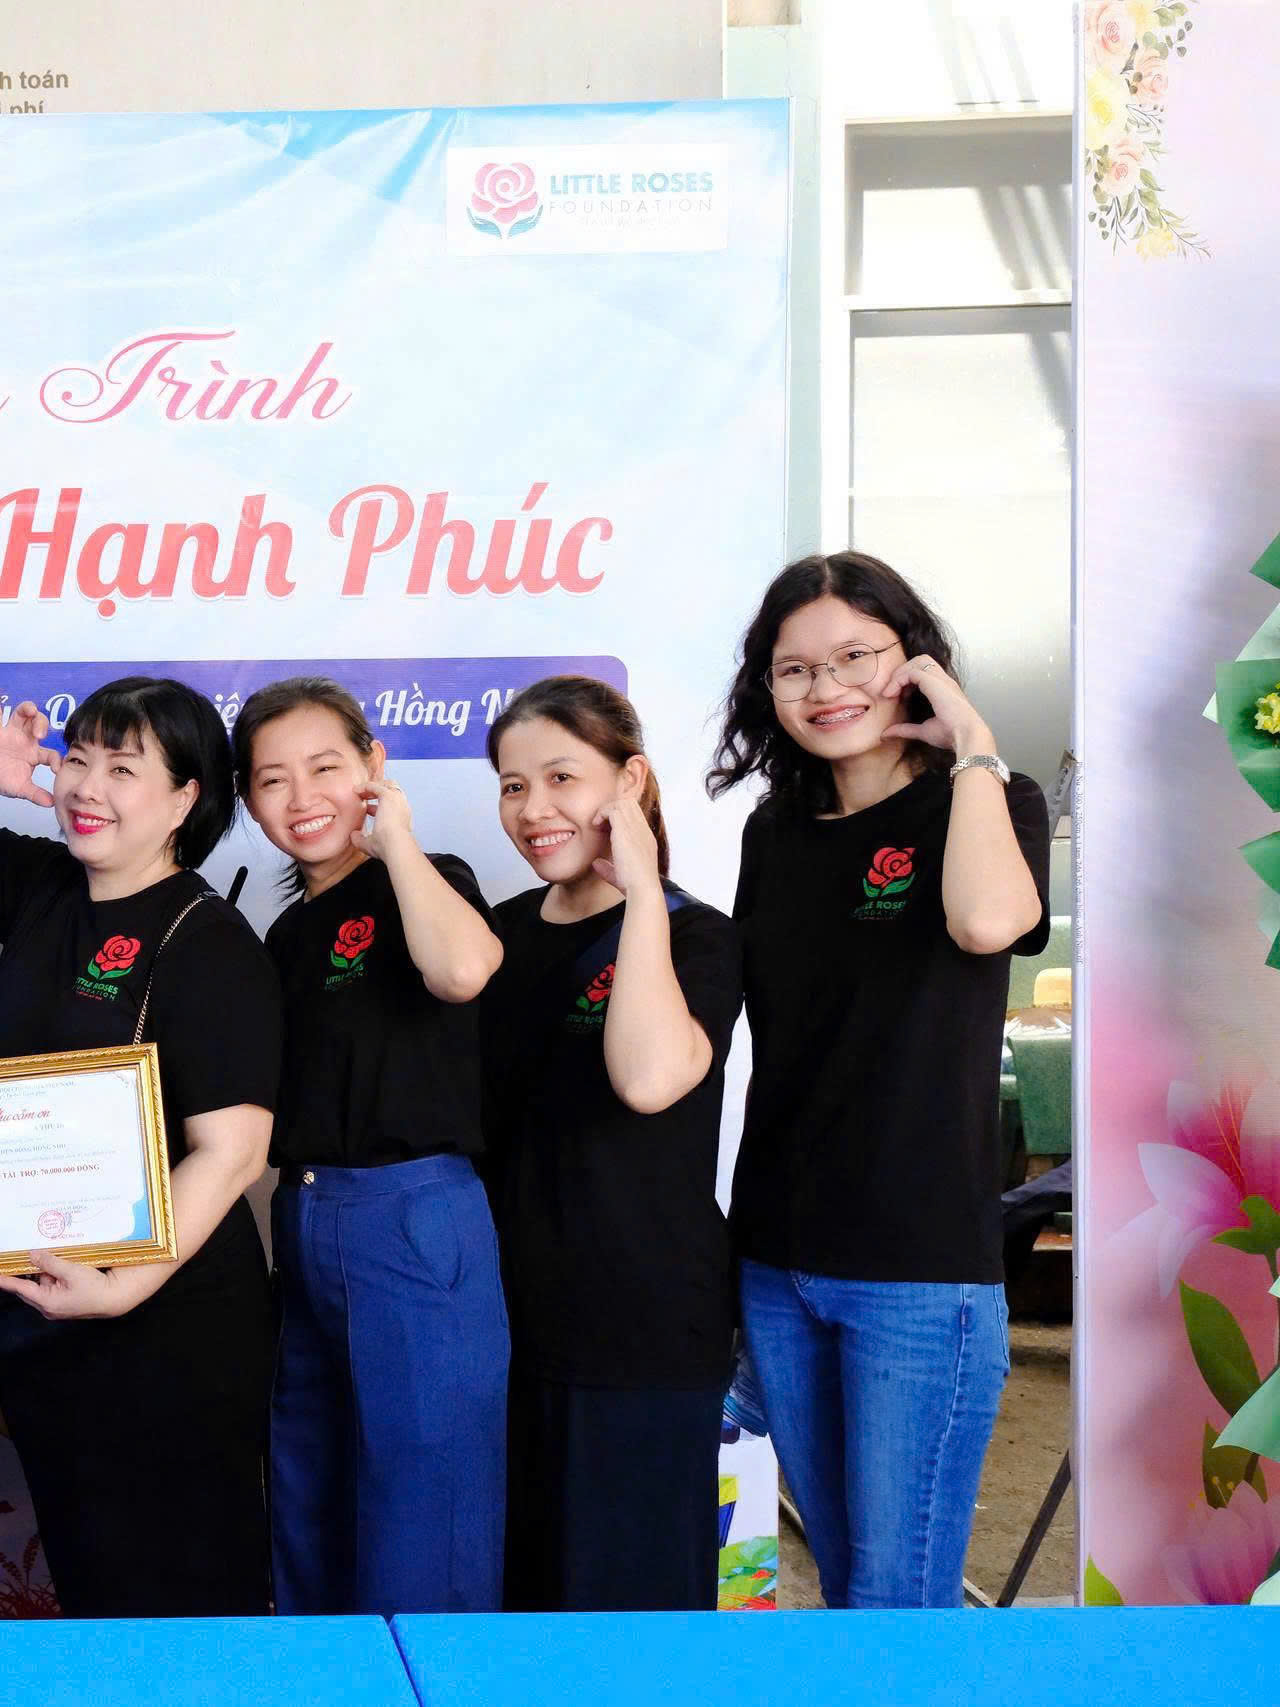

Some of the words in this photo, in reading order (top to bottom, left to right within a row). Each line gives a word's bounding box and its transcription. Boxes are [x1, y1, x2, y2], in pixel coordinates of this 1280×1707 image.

[20, 70, 69, 90] toán
[550, 174, 622, 195] LITTLE
[631, 172, 713, 193] ROSES
[549, 197, 713, 216] FOUNDATION
[39, 330, 353, 424] Trình
[328, 482, 614, 597] Phúc
[375, 682, 471, 737] Hồng
